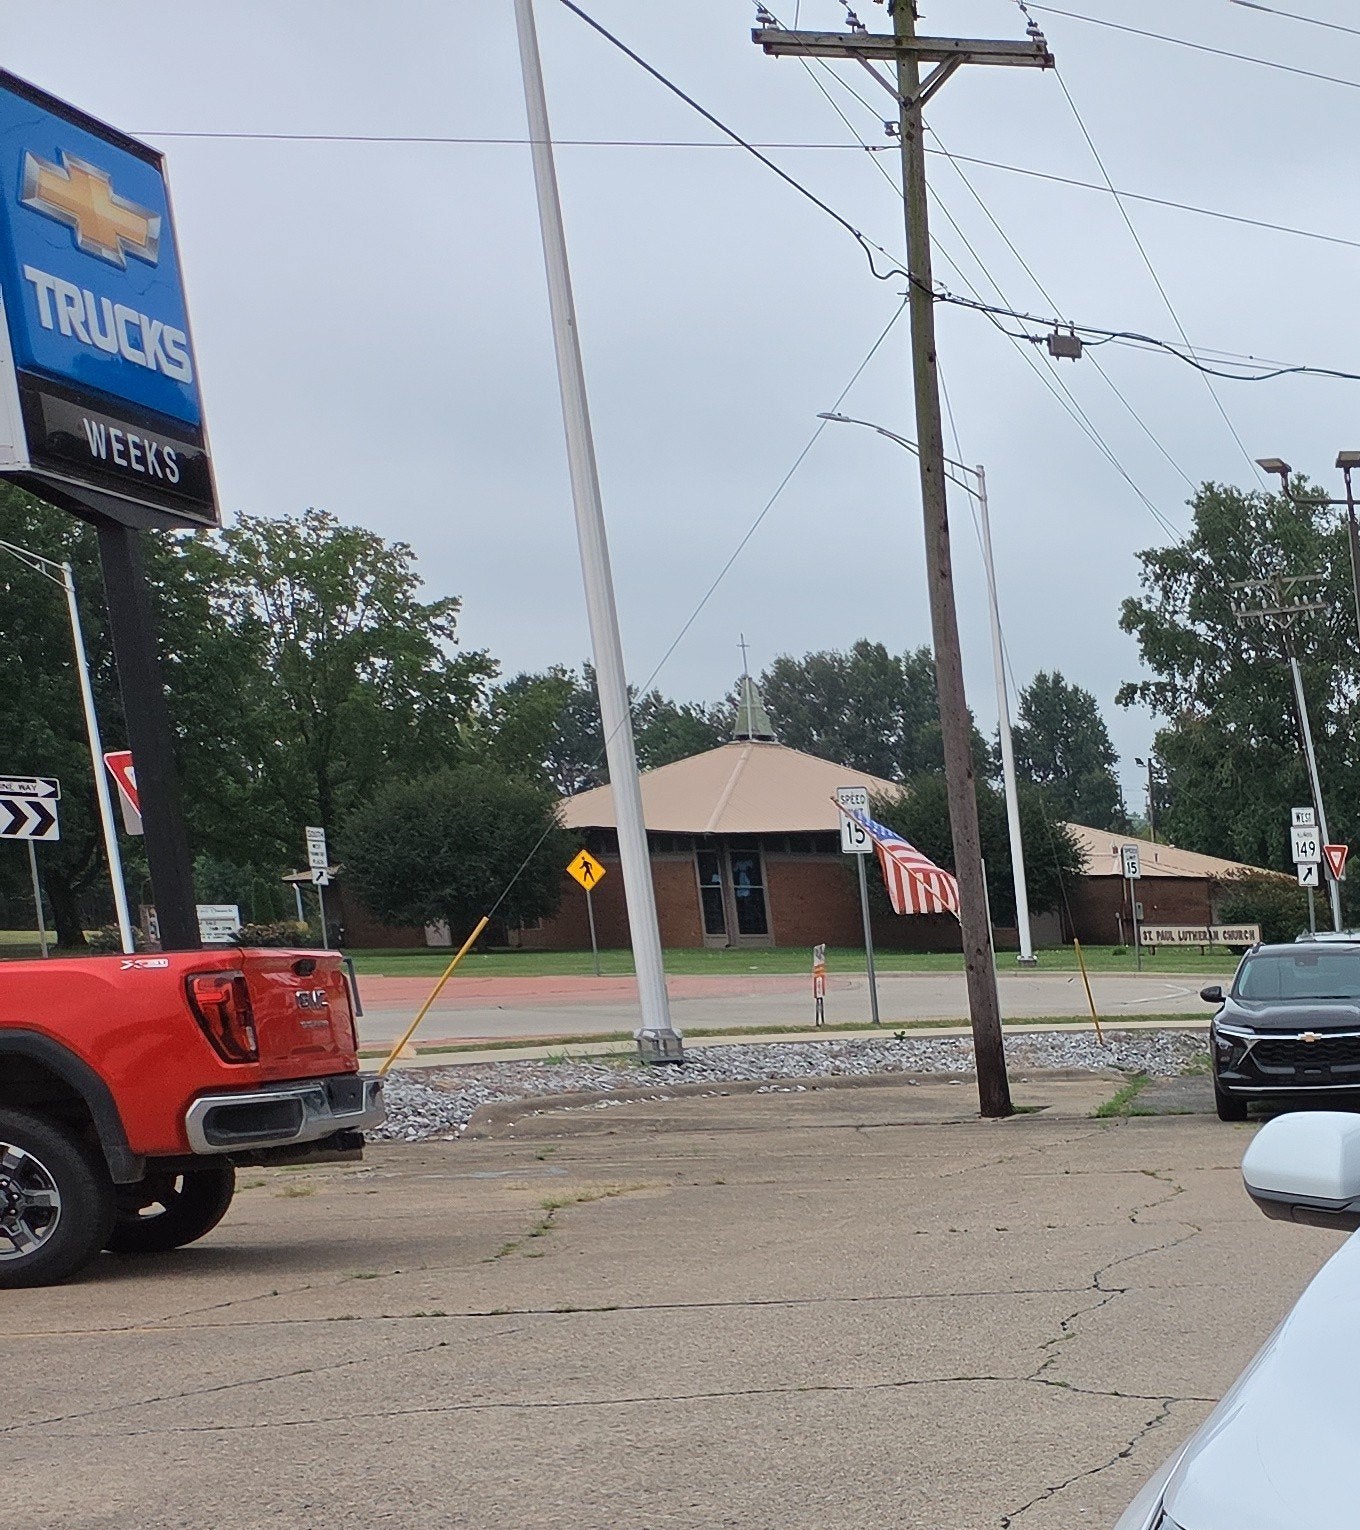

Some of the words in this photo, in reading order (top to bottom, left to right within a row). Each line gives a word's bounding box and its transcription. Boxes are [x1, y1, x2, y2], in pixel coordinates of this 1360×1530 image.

[23, 264, 193, 384] TRUCKS
[83, 417, 180, 484] WEEKS
[841, 794, 865, 805] SPEED
[1295, 812, 1312, 823] WEST
[847, 821, 866, 845] 15
[1295, 840, 1316, 858] 149
[1126, 861, 1138, 875] 15
[1156, 930, 1175, 941] PAUL
[1222, 930, 1255, 941] CHURCH
